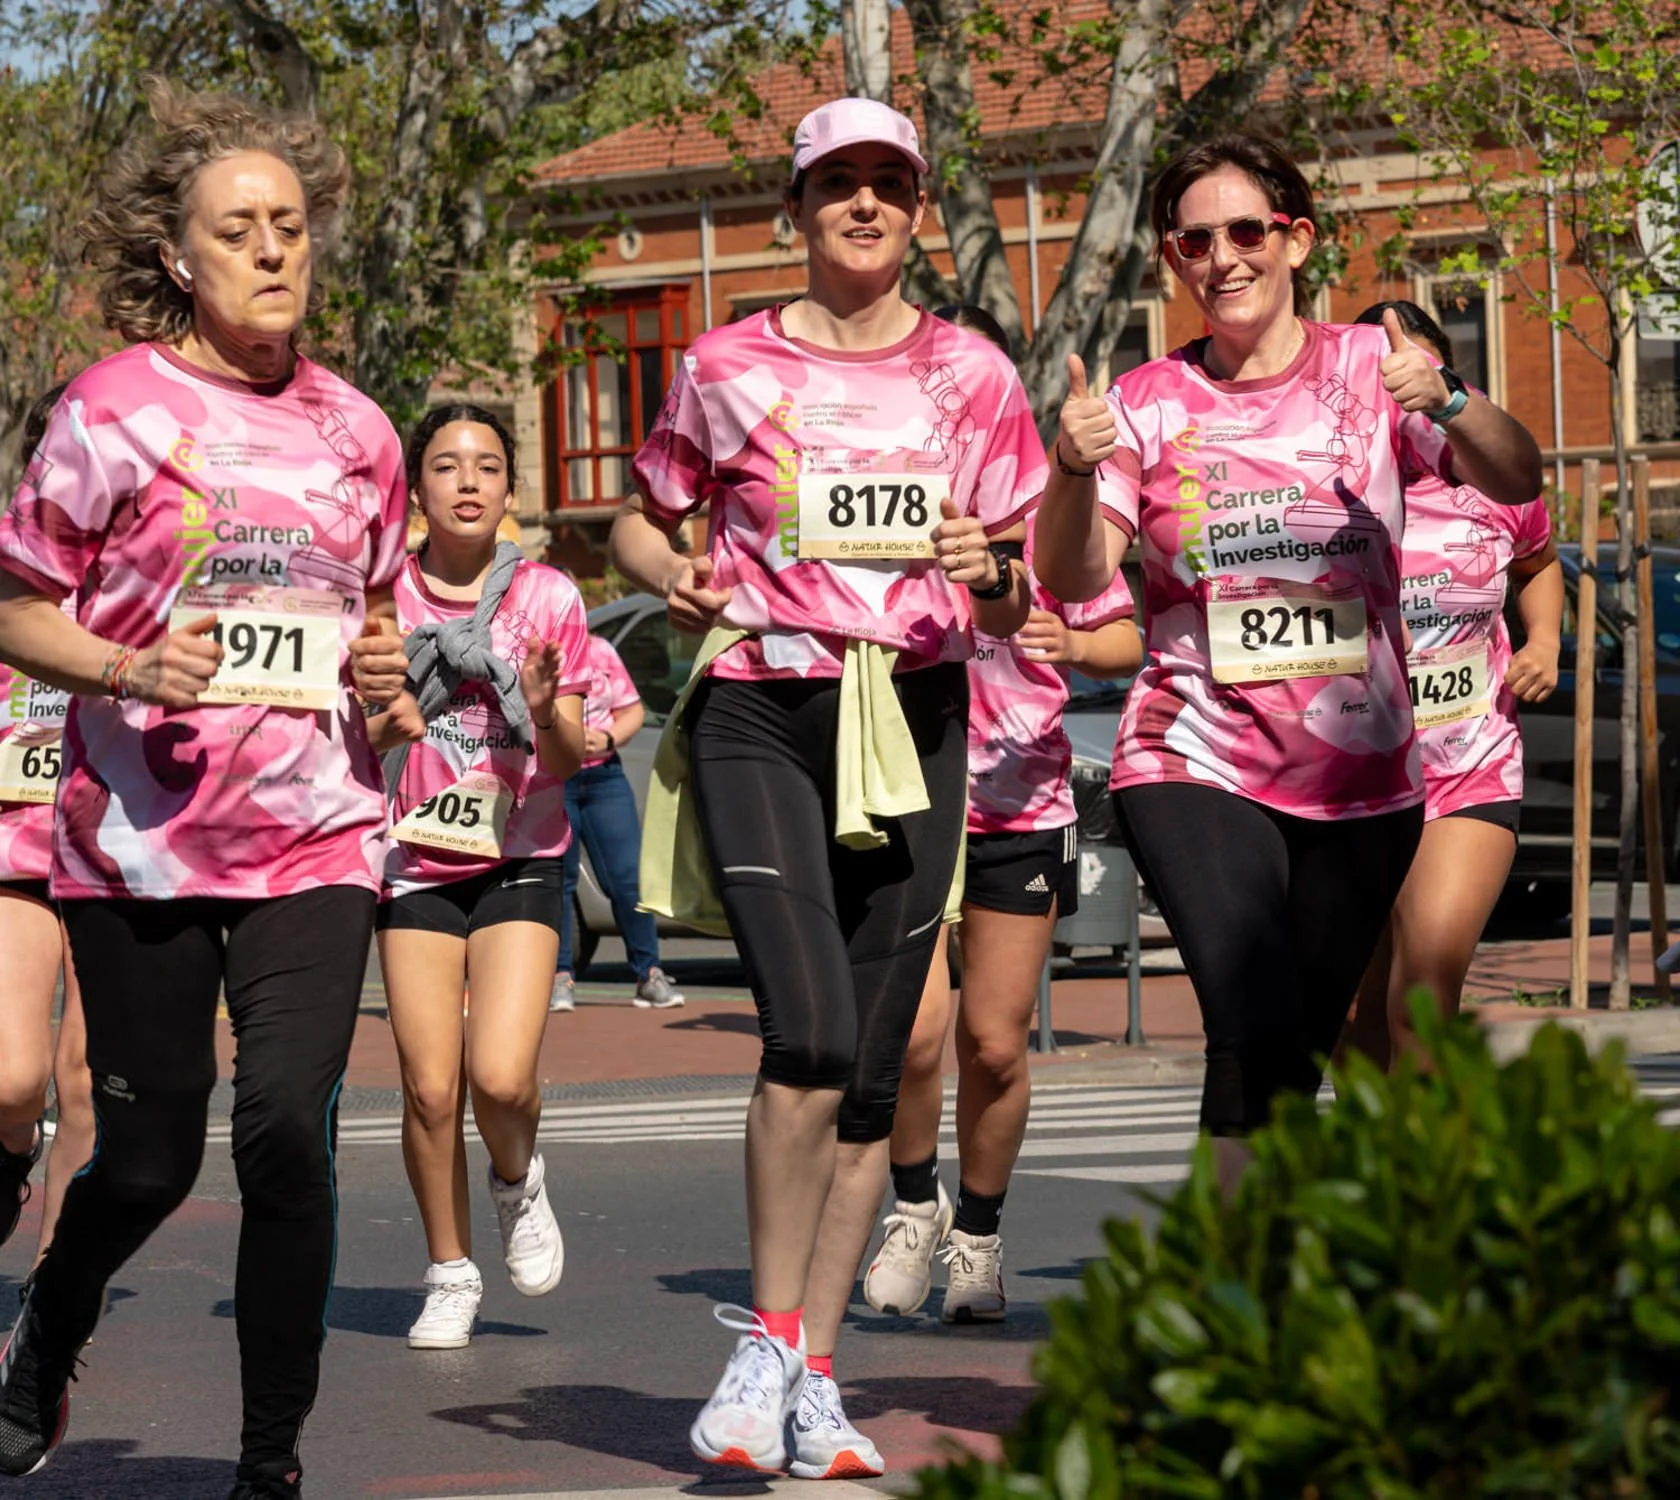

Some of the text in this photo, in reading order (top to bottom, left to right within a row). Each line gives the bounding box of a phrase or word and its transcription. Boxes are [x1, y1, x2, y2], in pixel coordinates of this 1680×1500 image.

[1204, 461, 1228, 482] XI
[211, 487, 237, 509] XI
[828, 484, 928, 528] 8178
[1206, 485, 1303, 510] Carrera
[214, 519, 312, 547] Carrera
[1208, 514, 1280, 547] por la
[211, 552, 283, 581] por la
[1212, 534, 1369, 568] Investigación
[1414, 593, 1432, 611] la
[1240, 606, 1335, 651] 8211
[204, 621, 304, 674] 1971
[1409, 666, 1474, 707] 1428
